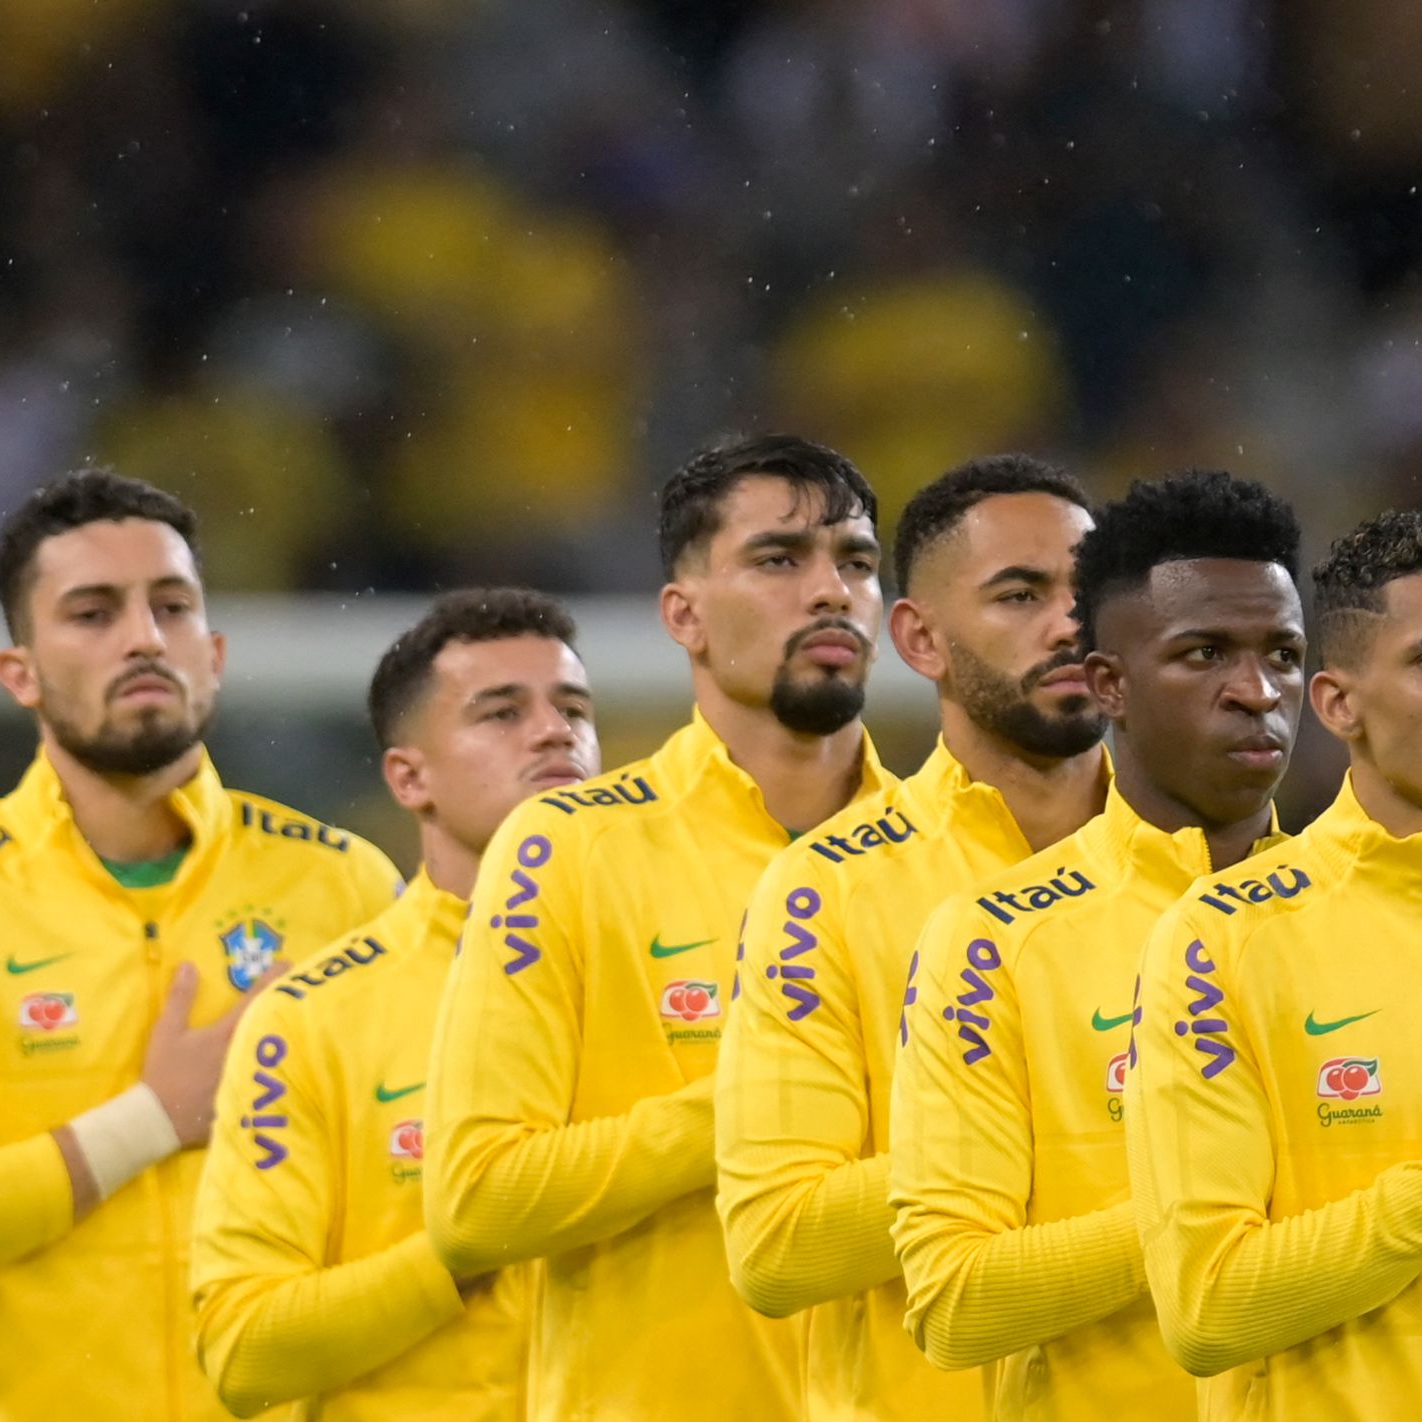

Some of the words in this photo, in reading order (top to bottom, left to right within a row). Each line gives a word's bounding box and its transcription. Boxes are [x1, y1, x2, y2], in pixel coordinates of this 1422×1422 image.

[539, 774, 659, 816] Itaú
[242, 801, 353, 854] Itaú
[808, 806, 919, 864] Itaú
[489, 833, 553, 976] vivo
[976, 865, 1097, 926] Itaú
[1199, 863, 1312, 917] Itaú
[274, 934, 388, 1001] Itaú
[765, 886, 822, 1021] vivo
[942, 938, 1002, 1066] vivo
[1174, 937, 1235, 1081] vivo
[239, 1033, 289, 1171] vivo
[1316, 1102, 1384, 1128] Guaraná
